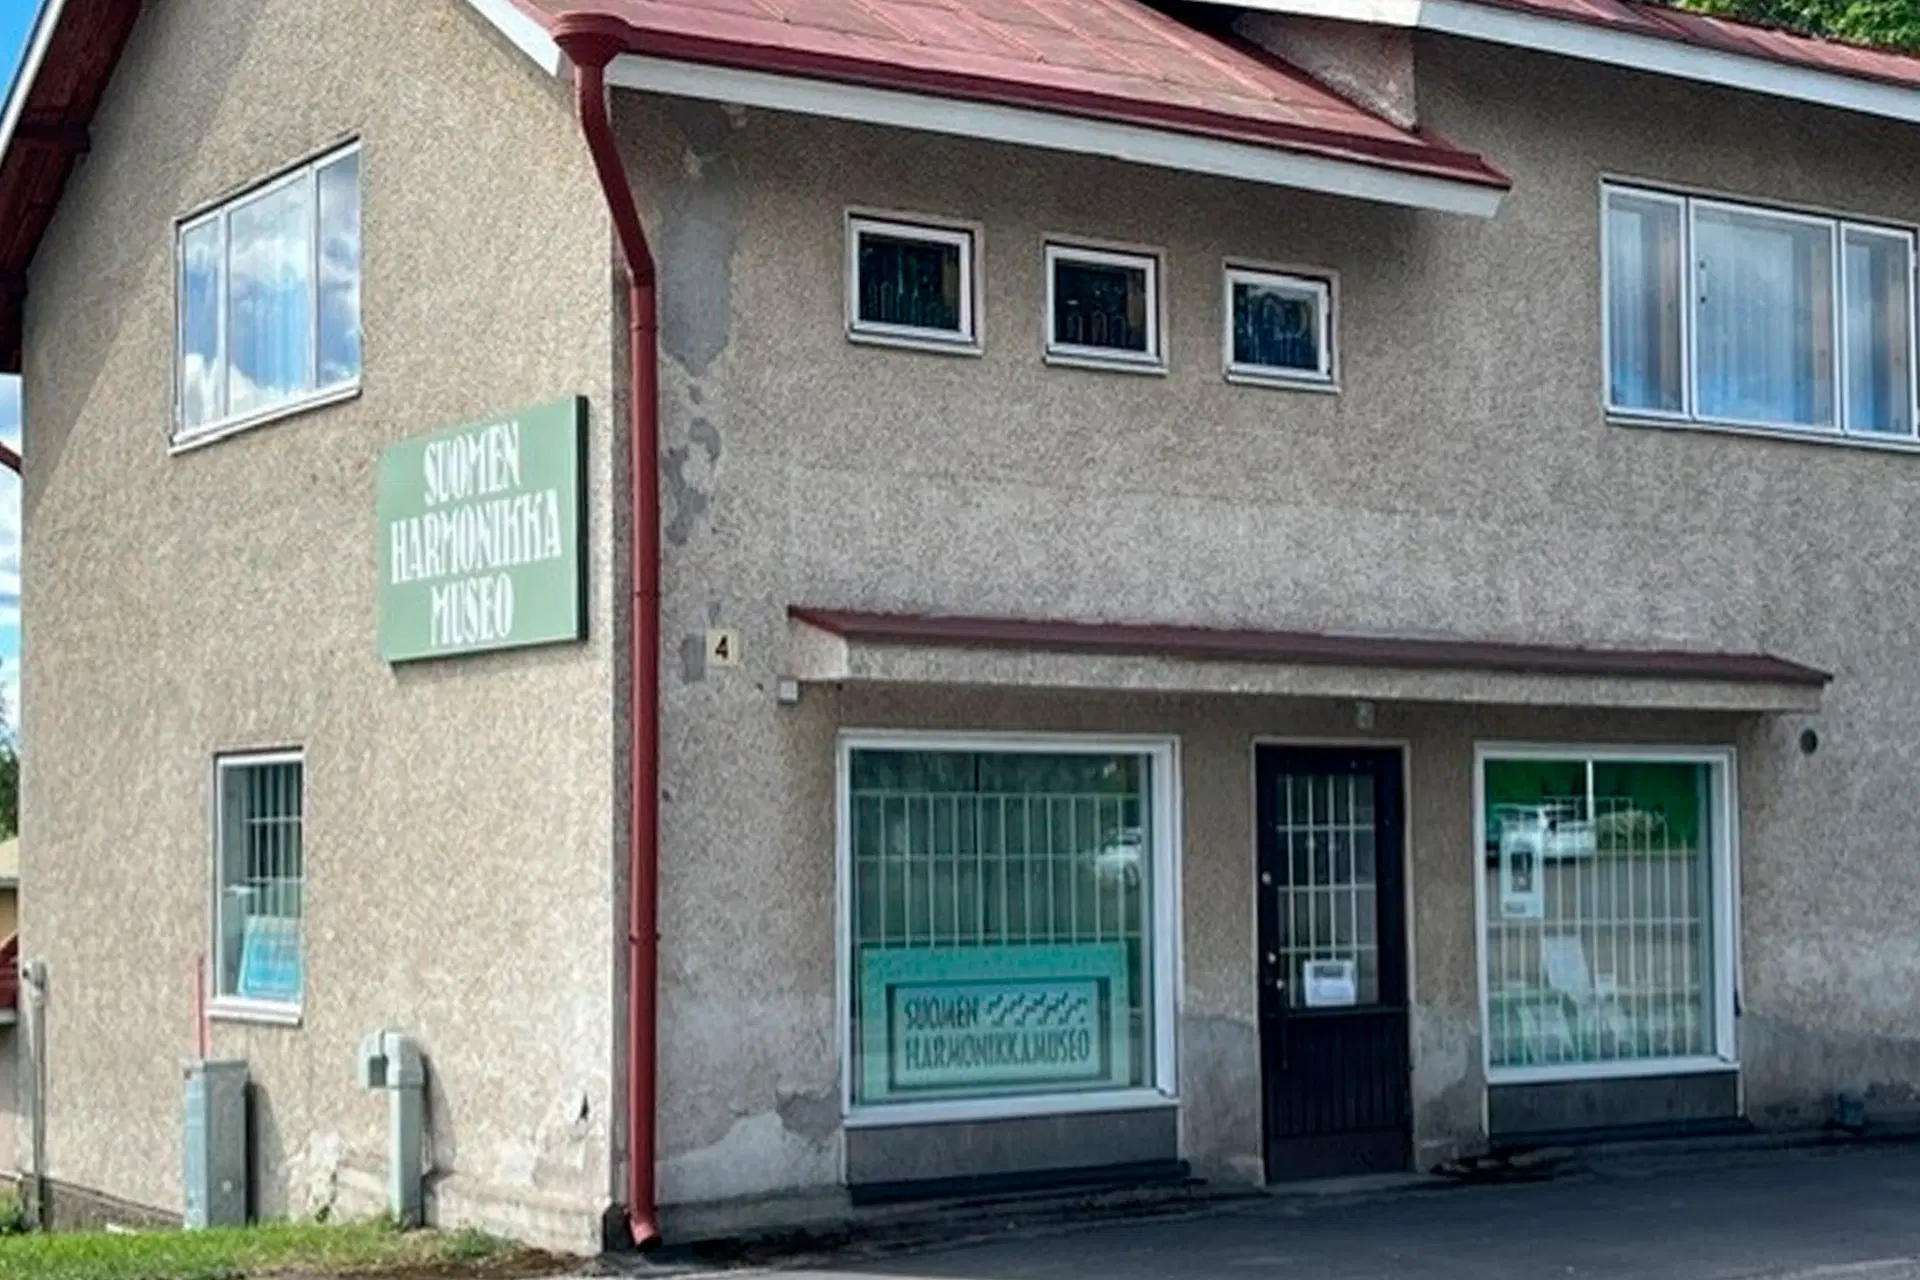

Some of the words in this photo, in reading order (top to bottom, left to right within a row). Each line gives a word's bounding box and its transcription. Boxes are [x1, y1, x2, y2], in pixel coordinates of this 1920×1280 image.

[422, 420, 521, 506] SUOMEN
[390, 488, 562, 585] HARMONIKKA
[430, 572, 515, 648] MUSEO
[715, 635, 729, 661] 4
[903, 994, 979, 1030] SUOMEN
